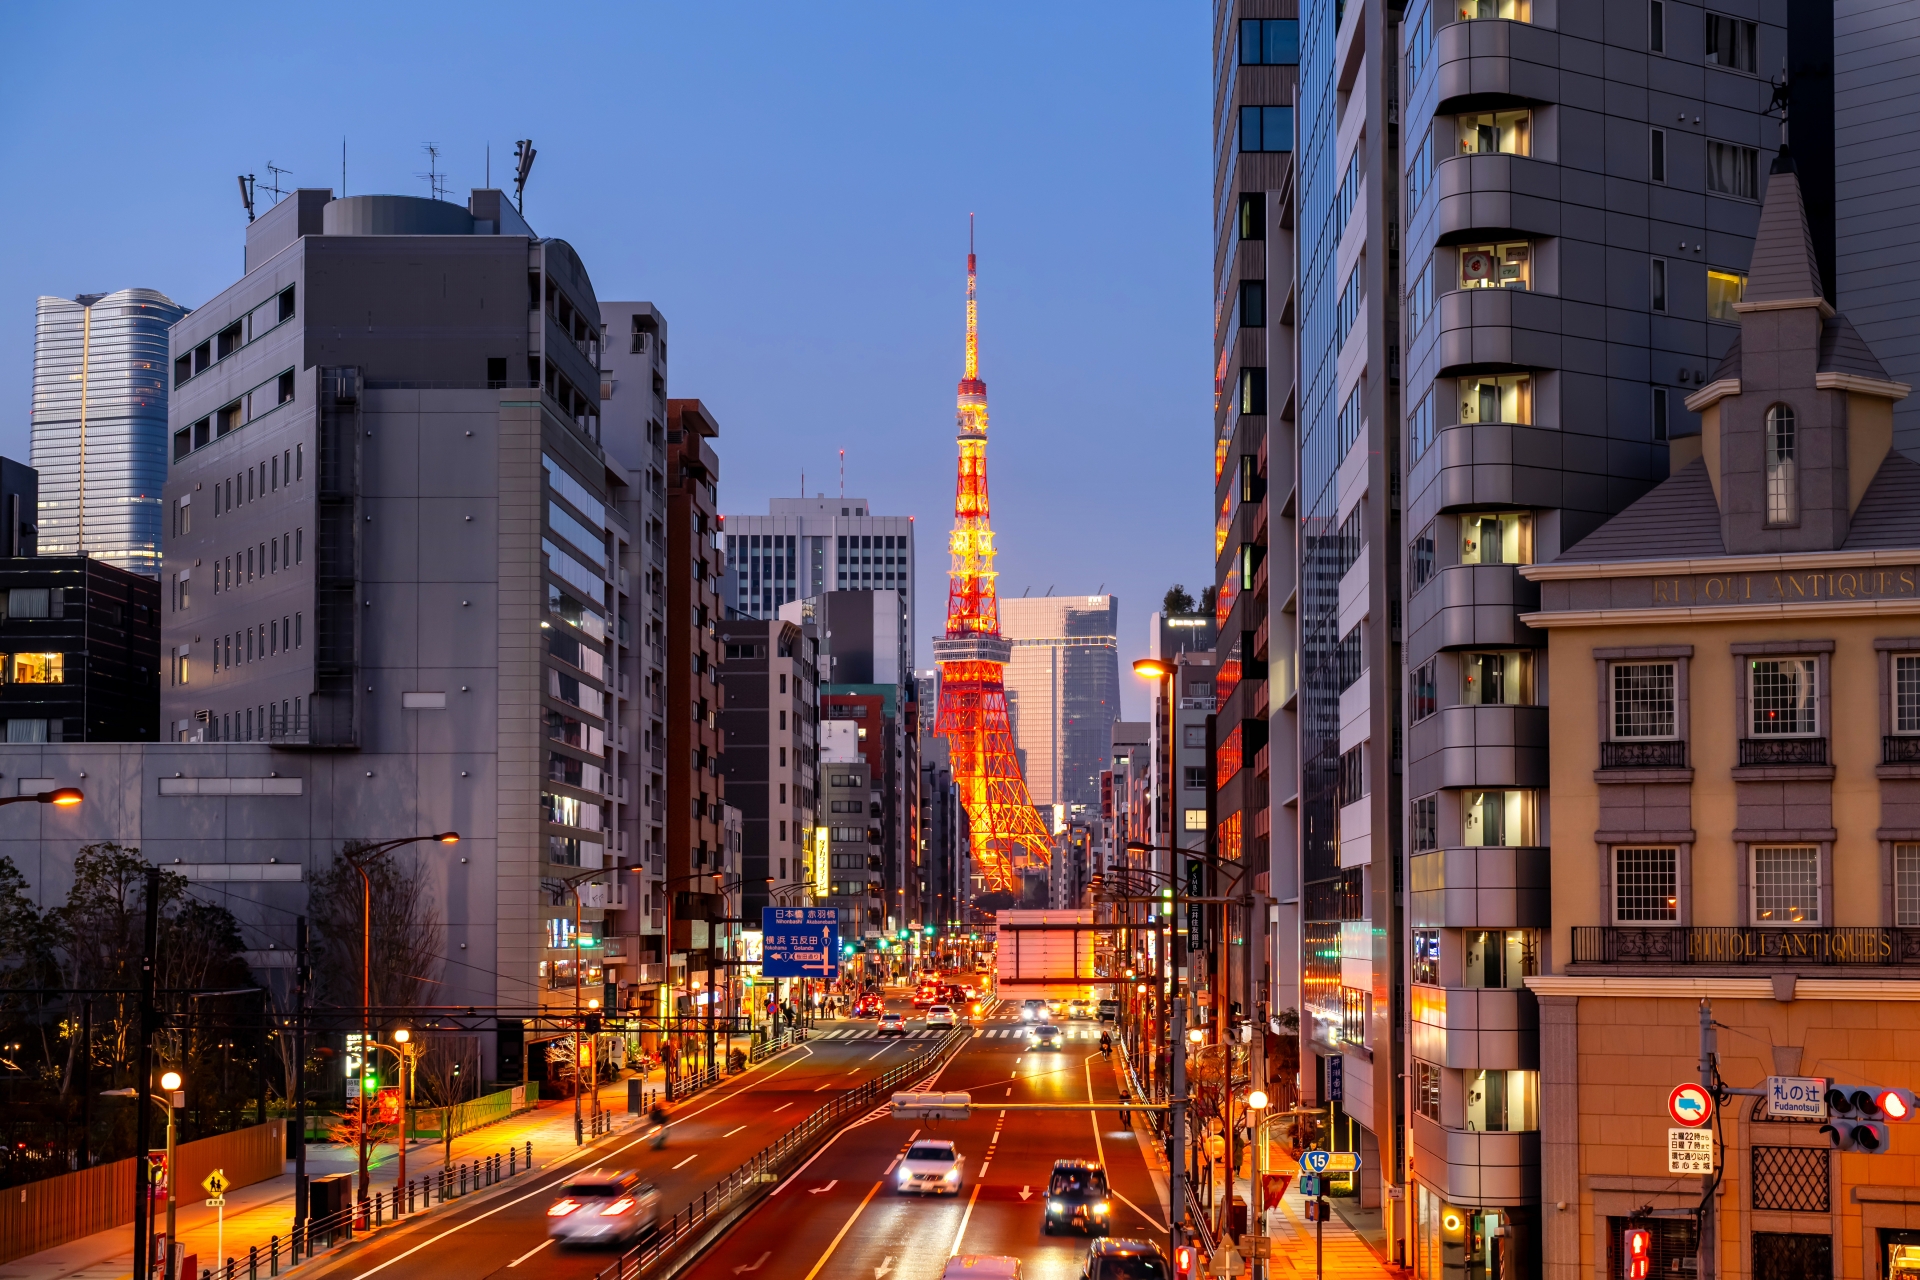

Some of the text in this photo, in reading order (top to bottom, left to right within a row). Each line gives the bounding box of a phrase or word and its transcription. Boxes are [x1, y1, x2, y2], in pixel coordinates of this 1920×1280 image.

[1767, 570, 1915, 599] ANTIQUES
[776, 909, 836, 919] 日本橋 赤羽橋
[766, 935, 818, 945] 横浜 五反田
[1689, 933, 1892, 959] RIVOLI ANTIQUES
[1773, 1084, 1821, 1102] 札の辻
[1774, 1101, 1820, 1114] Fudanotsuji
[1312, 1154, 1326, 1167] 15
[1671, 1151, 1711, 1161] 環七通り以内
[1671, 1160, 1711, 1170] 都心全域
